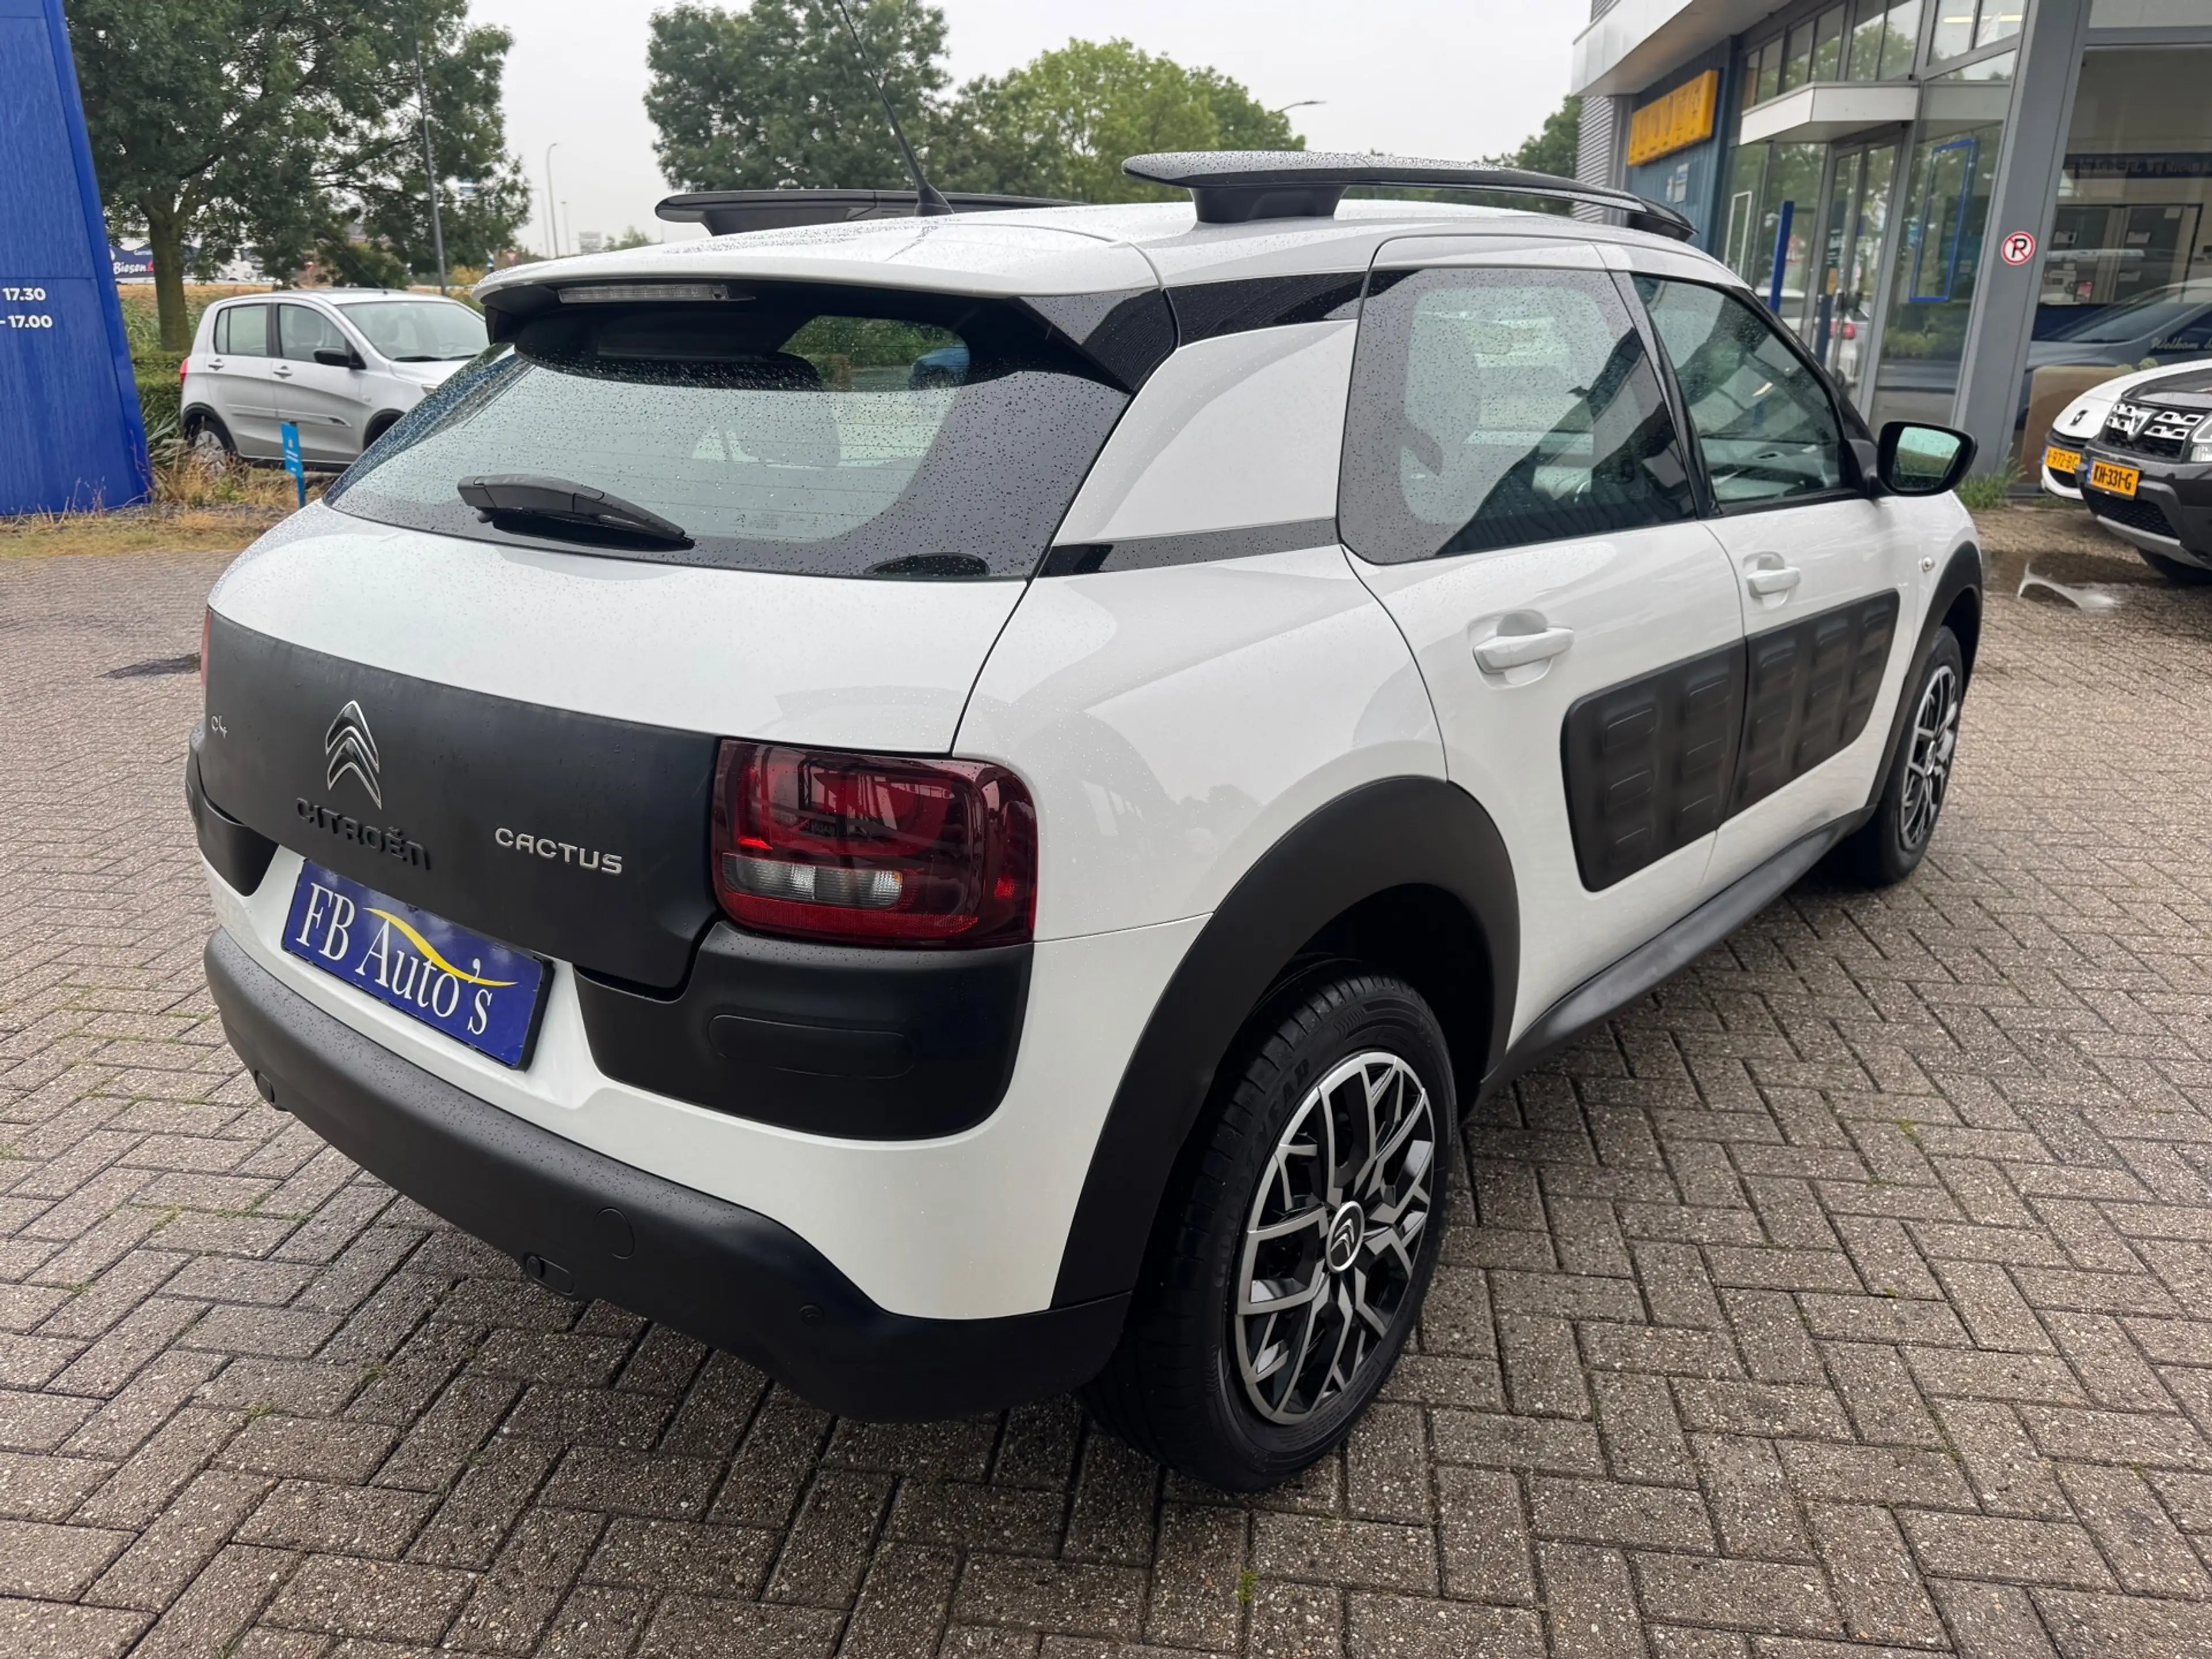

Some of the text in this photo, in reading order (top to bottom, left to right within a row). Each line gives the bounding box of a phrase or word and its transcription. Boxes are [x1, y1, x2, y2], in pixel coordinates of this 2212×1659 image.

[2, 287, 46, 301] 17.30
[7, 315, 53, 328] 17.00
[211, 715, 228, 738] C4
[296, 797, 431, 871] CITROËN
[495, 827, 622, 876] CACTUS
[296, 882, 493, 1035] FB Auto's
